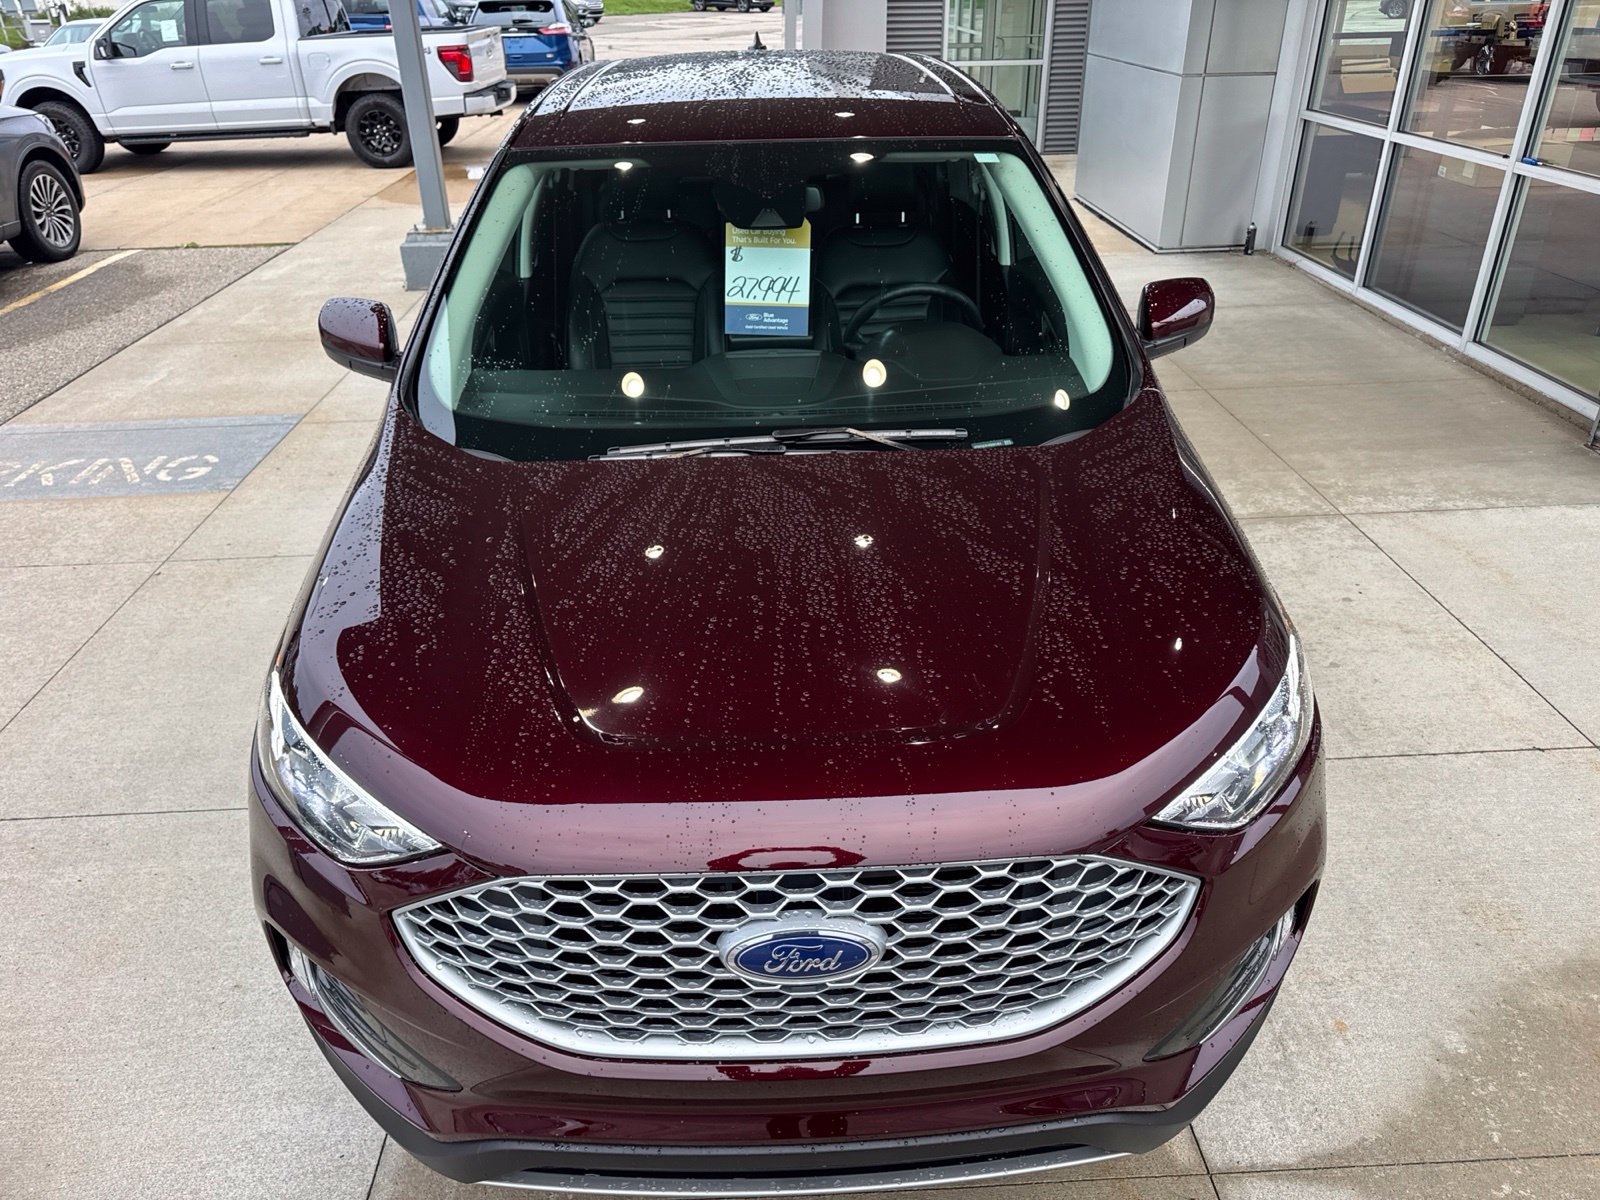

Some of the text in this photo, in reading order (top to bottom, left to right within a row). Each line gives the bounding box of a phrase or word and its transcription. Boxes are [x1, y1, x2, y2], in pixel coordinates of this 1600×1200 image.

[732, 235, 752, 243] That's
[782, 237, 797, 245] You.
[730, 246, 744, 262] $
[764, 944, 843, 974] Ford
